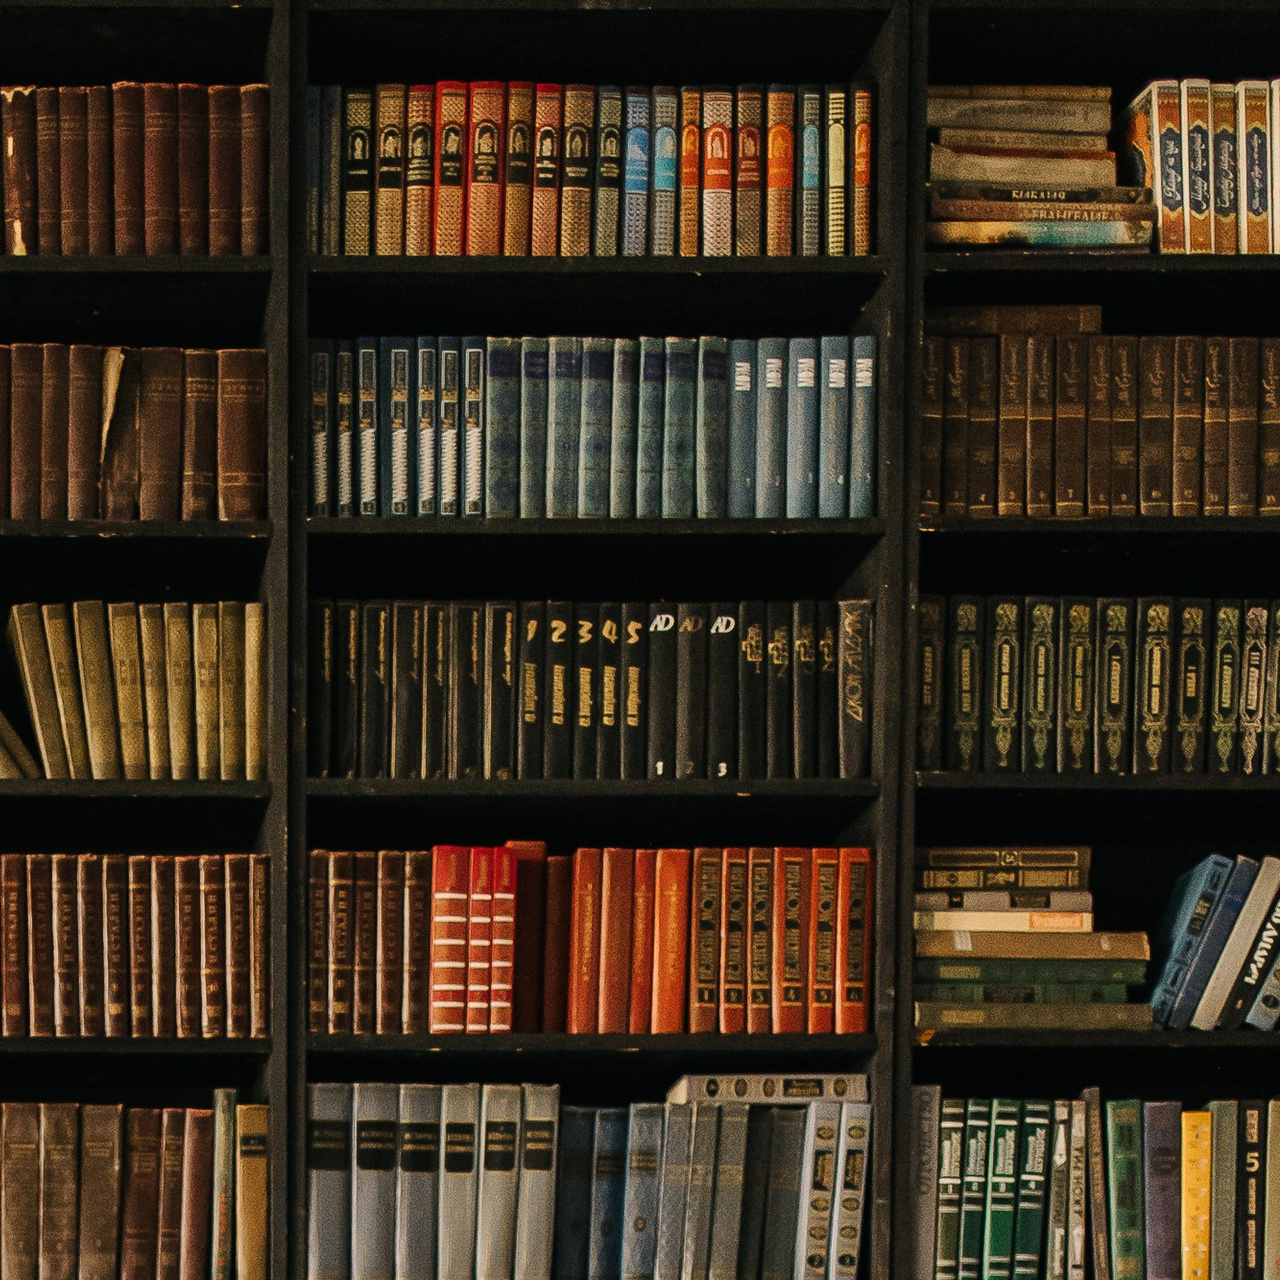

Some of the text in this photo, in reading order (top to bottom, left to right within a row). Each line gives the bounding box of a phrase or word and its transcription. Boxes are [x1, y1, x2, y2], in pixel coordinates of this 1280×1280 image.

[527, 620, 538, 642] 1
[550, 620, 566, 643] 2
[578, 620, 593, 644] 3
[602, 619, 617, 643] 4
[627, 620, 643, 645] 5
[650, 615, 675, 632] AD
[710, 617, 736, 634] AD
[656, 762, 664, 776] 1
[718, 763, 728, 777] 3
[1246, 1152, 1260, 1173] 5
[948, 1183, 954, 1194] 1
[1029, 1181, 1037, 1190] 4
